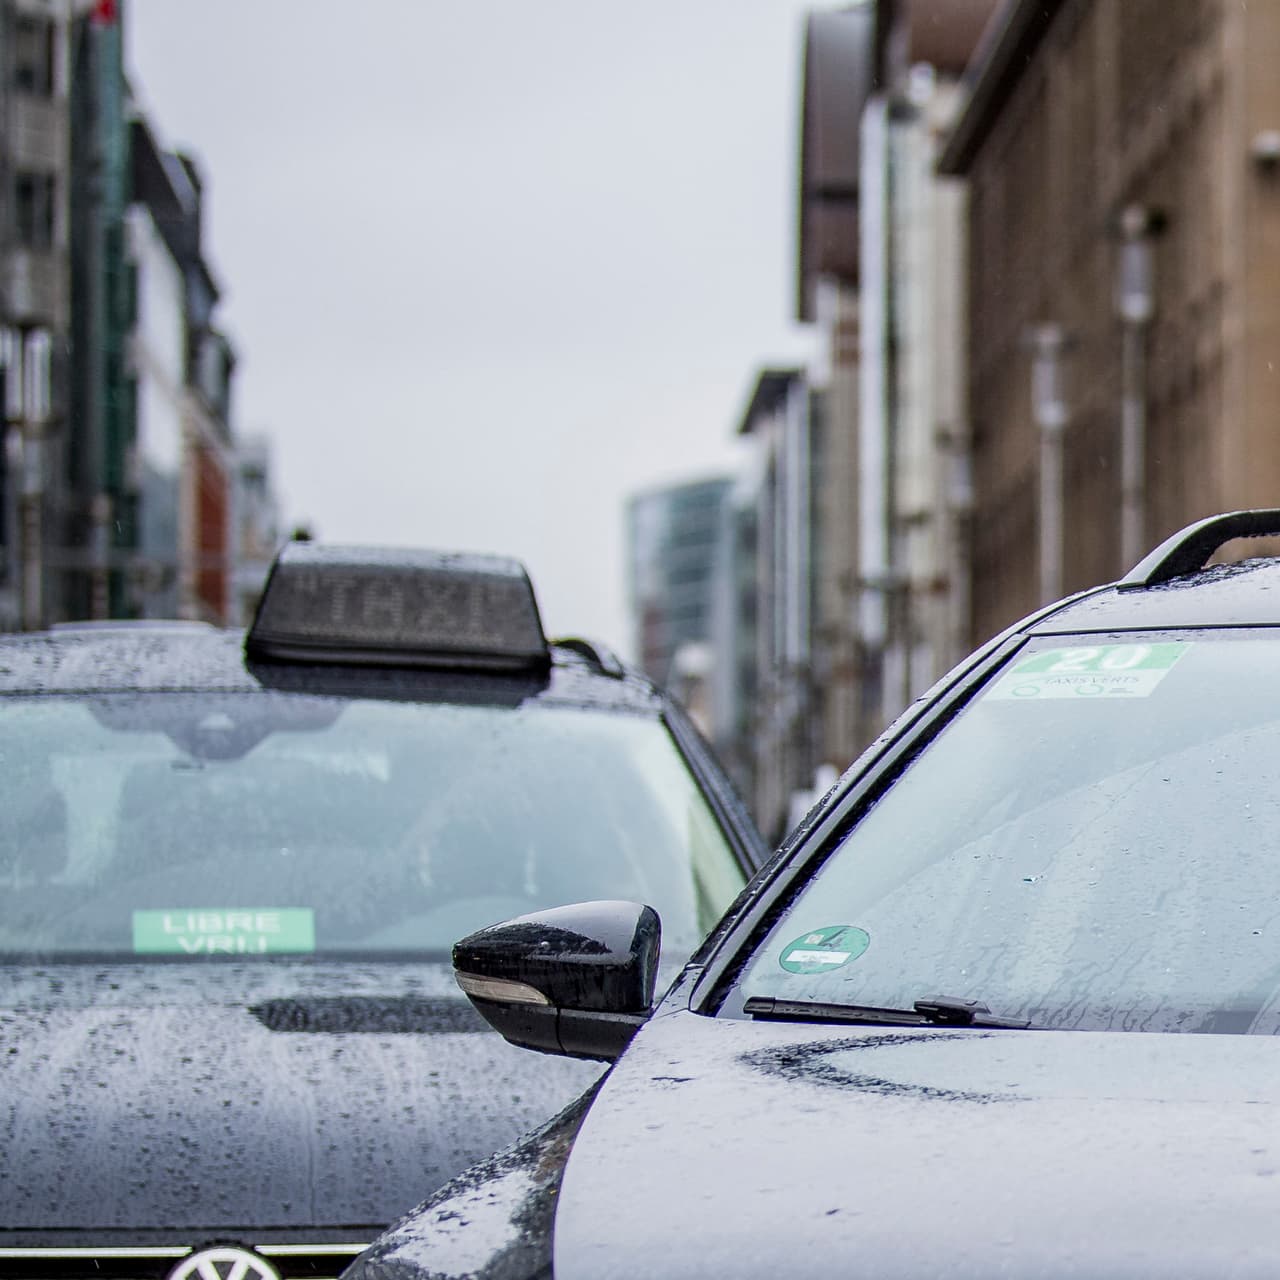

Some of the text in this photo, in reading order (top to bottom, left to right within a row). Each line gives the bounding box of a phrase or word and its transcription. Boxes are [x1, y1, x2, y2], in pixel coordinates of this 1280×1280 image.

[1049, 645, 1152, 671] 20
[163, 911, 281, 934] LIBRE
[178, 936, 267, 954] VRIJ
